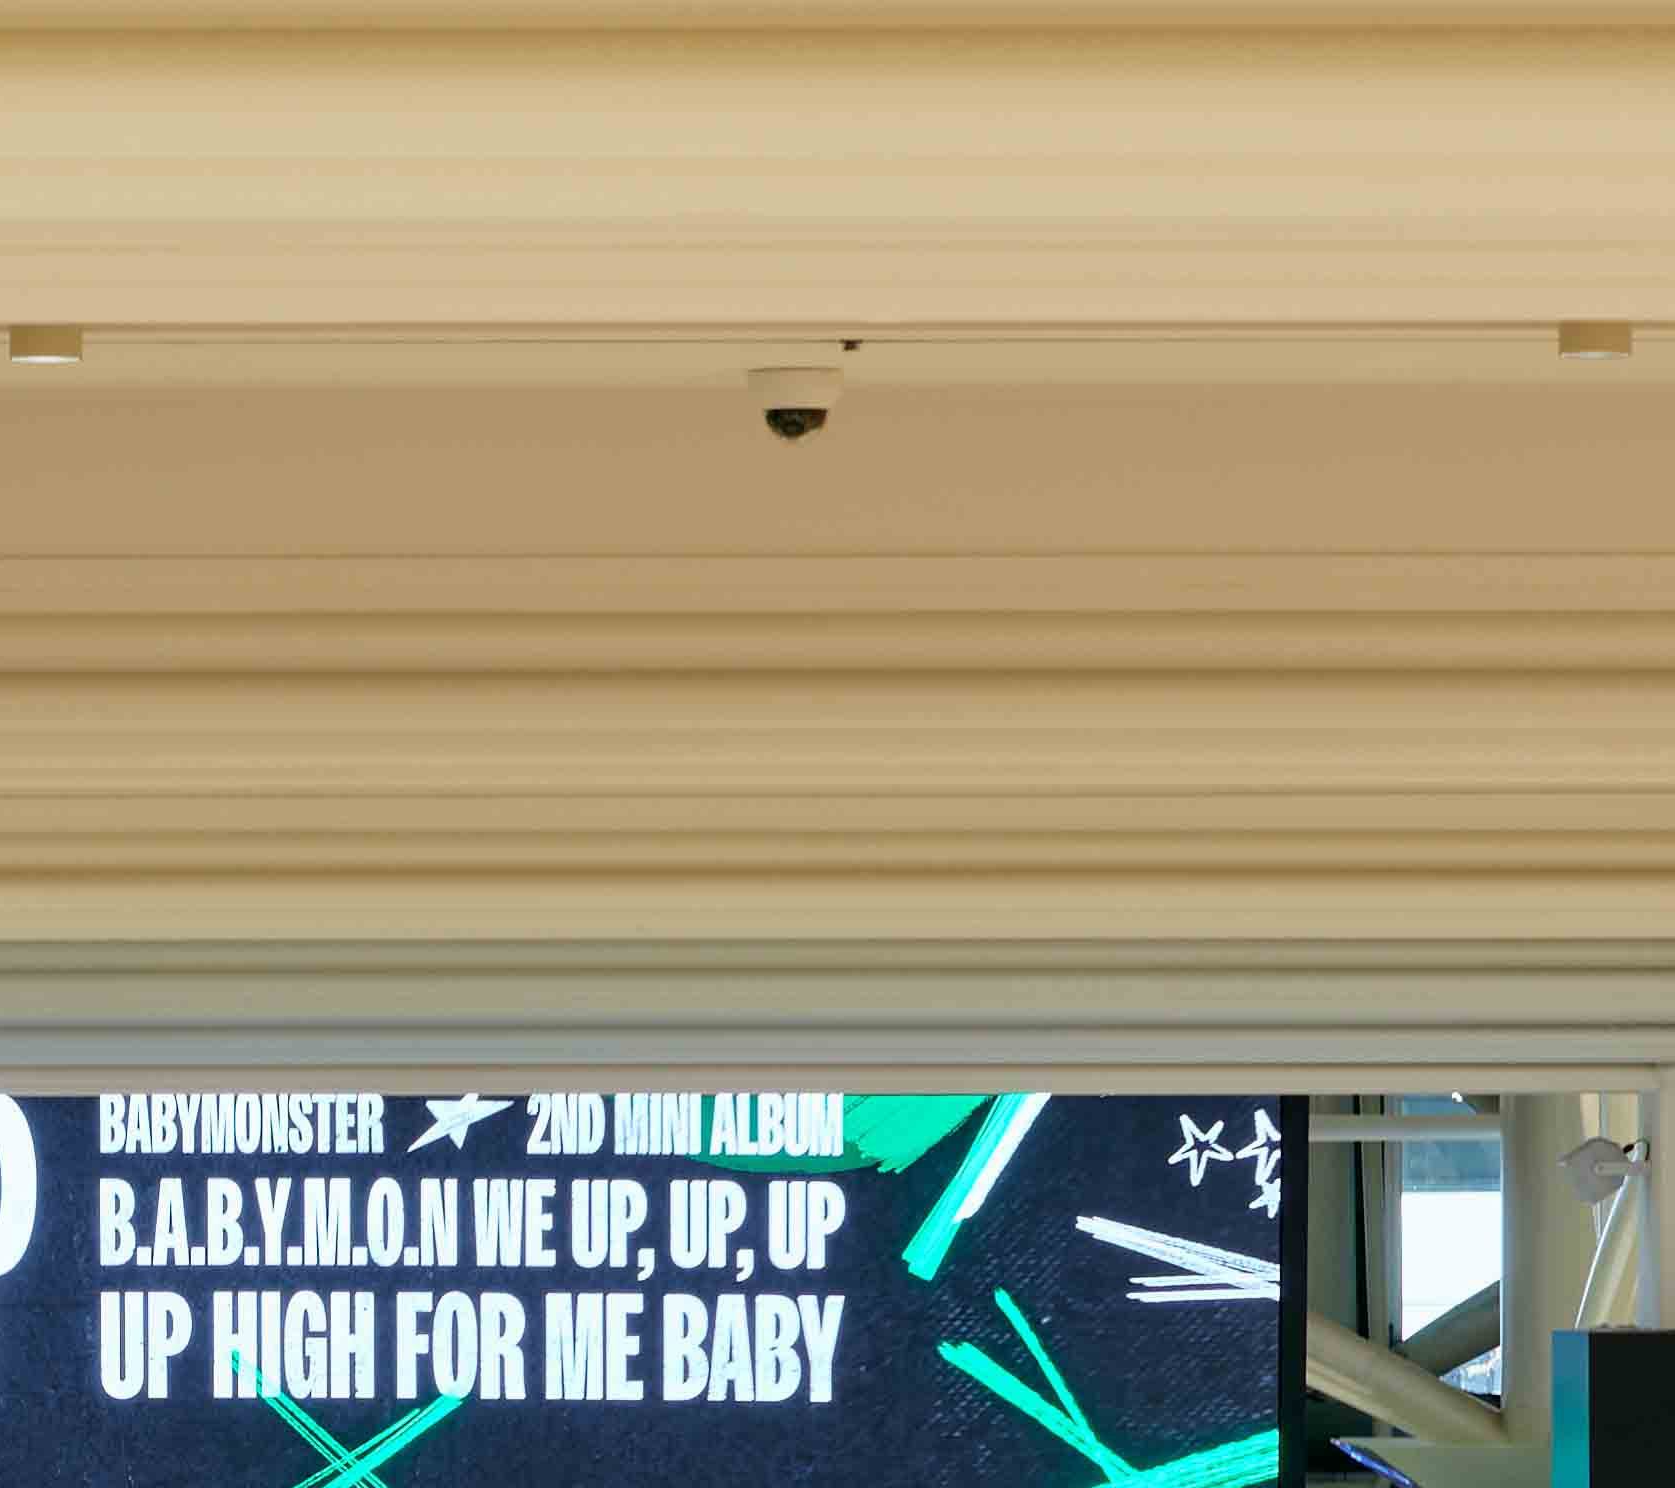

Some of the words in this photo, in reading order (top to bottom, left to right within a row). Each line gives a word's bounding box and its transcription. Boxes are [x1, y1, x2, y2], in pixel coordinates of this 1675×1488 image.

[99, 1092, 385, 1154] BABYMONSTER
[526, 1092, 606, 1155] 2ND
[614, 1092, 702, 1156] MINI
[709, 1092, 845, 1157] ALBUM
[99, 1177, 458, 1267] B.A.B.Y.M.O.N
[473, 1178, 557, 1268] WE
[571, 1179, 656, 1281] UP,
[669, 1179, 755, 1282] UP,
[768, 1180, 846, 1270] UP
[99, 1290, 194, 1400] UP
[213, 1290, 375, 1400] HIGH
[396, 1290, 527, 1400] FOR
[545, 1291, 645, 1400] ME
[662, 1293, 846, 1403] BABY
